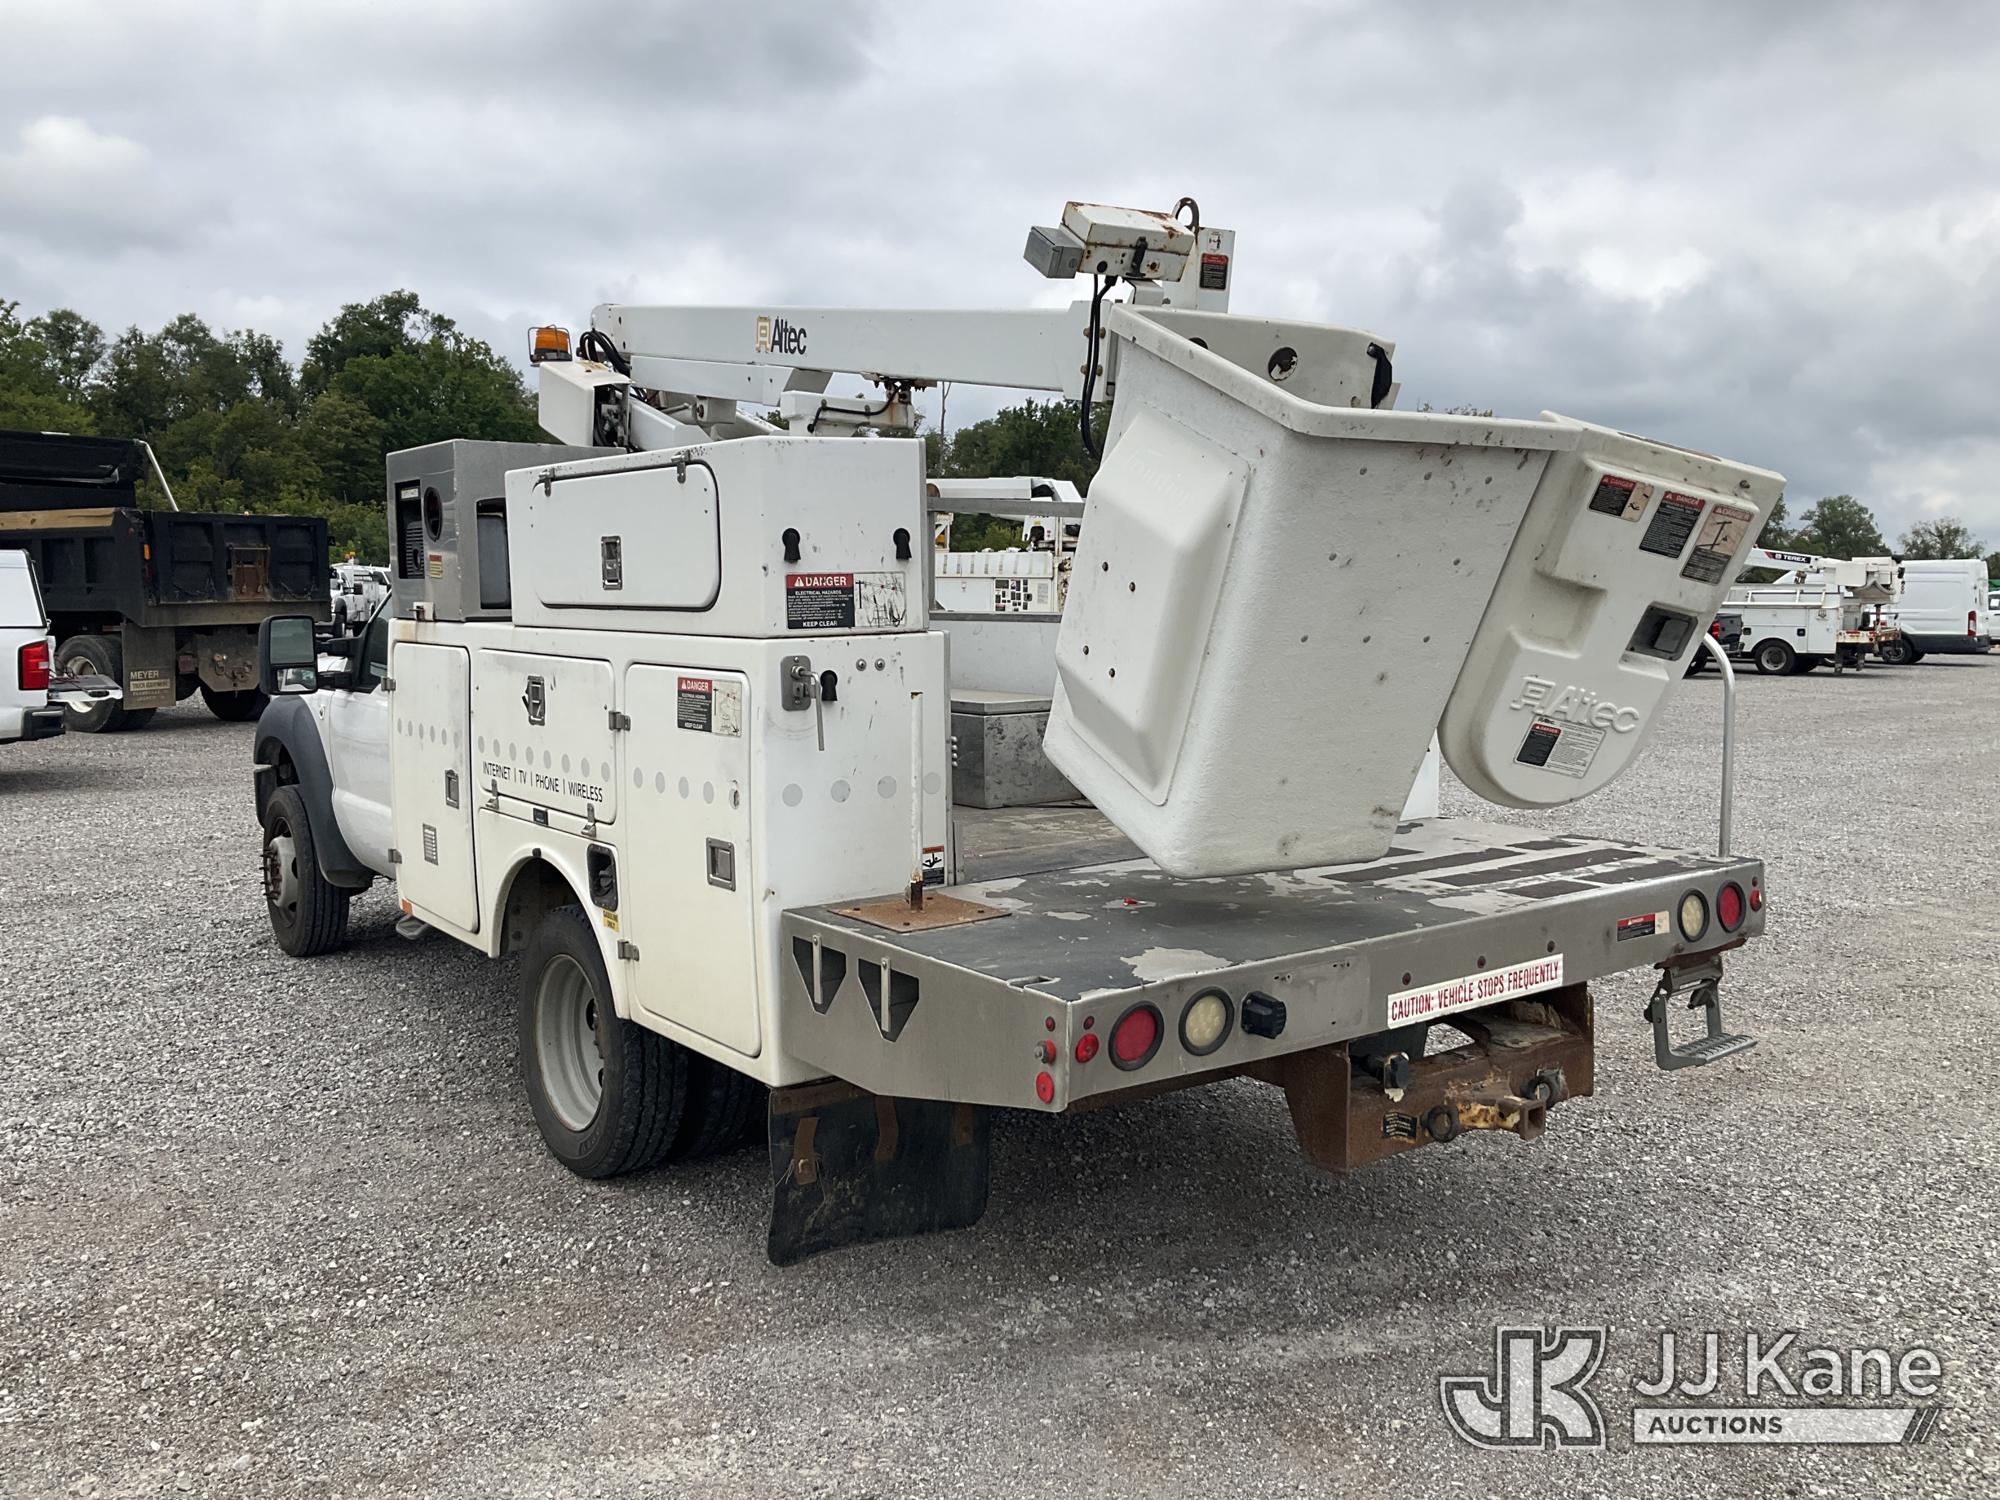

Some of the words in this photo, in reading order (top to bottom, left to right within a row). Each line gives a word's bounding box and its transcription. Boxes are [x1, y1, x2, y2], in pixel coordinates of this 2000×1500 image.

[770, 318, 807, 355] Altec
[1783, 554, 1807, 563] TEREX
[805, 576, 847, 587] DANGER
[130, 670, 160, 680] MEYER
[686, 680, 709, 692] DANGER
[1545, 685, 1640, 733] Altec
[483, 761, 511, 780] INTERNET
[518, 769, 527, 785] TV
[535, 773, 560, 793] PHONE
[568, 780, 603, 803] WIRELESS
[1391, 995, 1434, 1021] CAUTION:
[1438, 982, 1474, 1009] VEHICLE
[1477, 975, 1505, 1000] STOPS
[1507, 960, 1559, 991] FREQUENTLY
